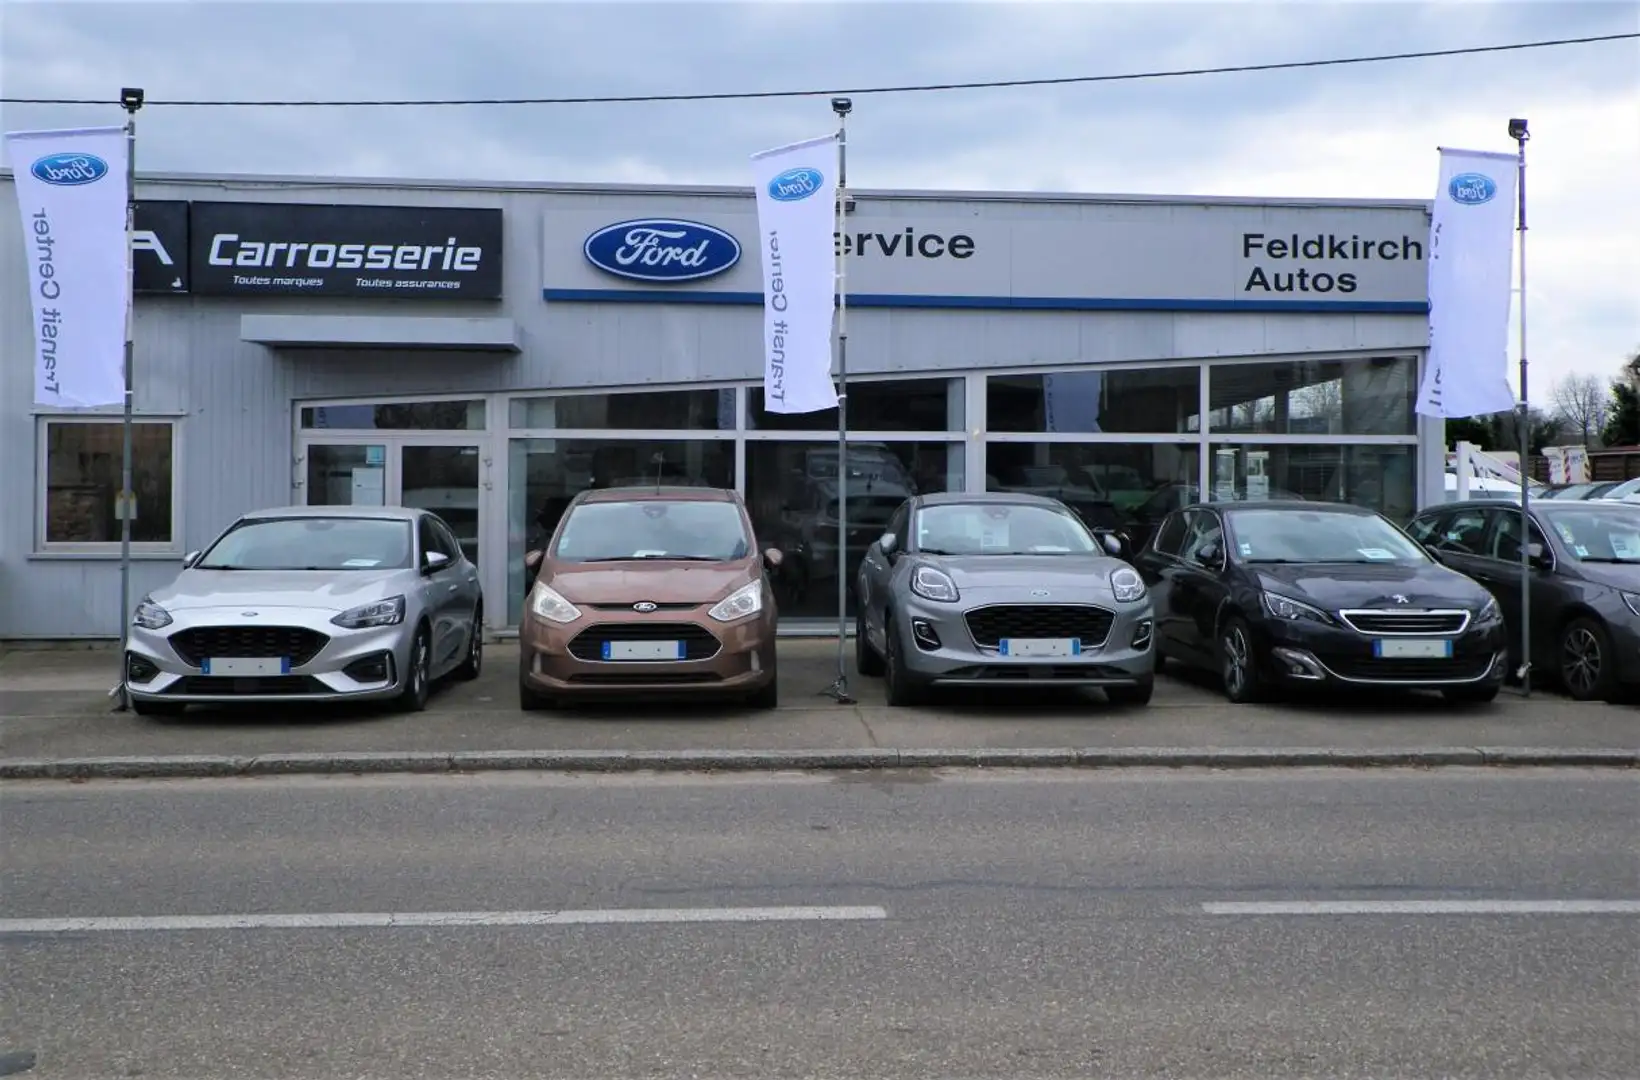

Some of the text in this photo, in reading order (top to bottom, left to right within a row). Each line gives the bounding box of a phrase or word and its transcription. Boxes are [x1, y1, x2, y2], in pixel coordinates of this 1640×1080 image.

[208, 233, 482, 271] Carrosserie
[615, 227, 975, 268] Ford ervice
[1243, 233, 1423, 260] Feldkirch
[233, 275, 323, 287] Toutes marques
[356, 278, 461, 289] Toutes assurances
[1244, 266, 1357, 293] Autos
